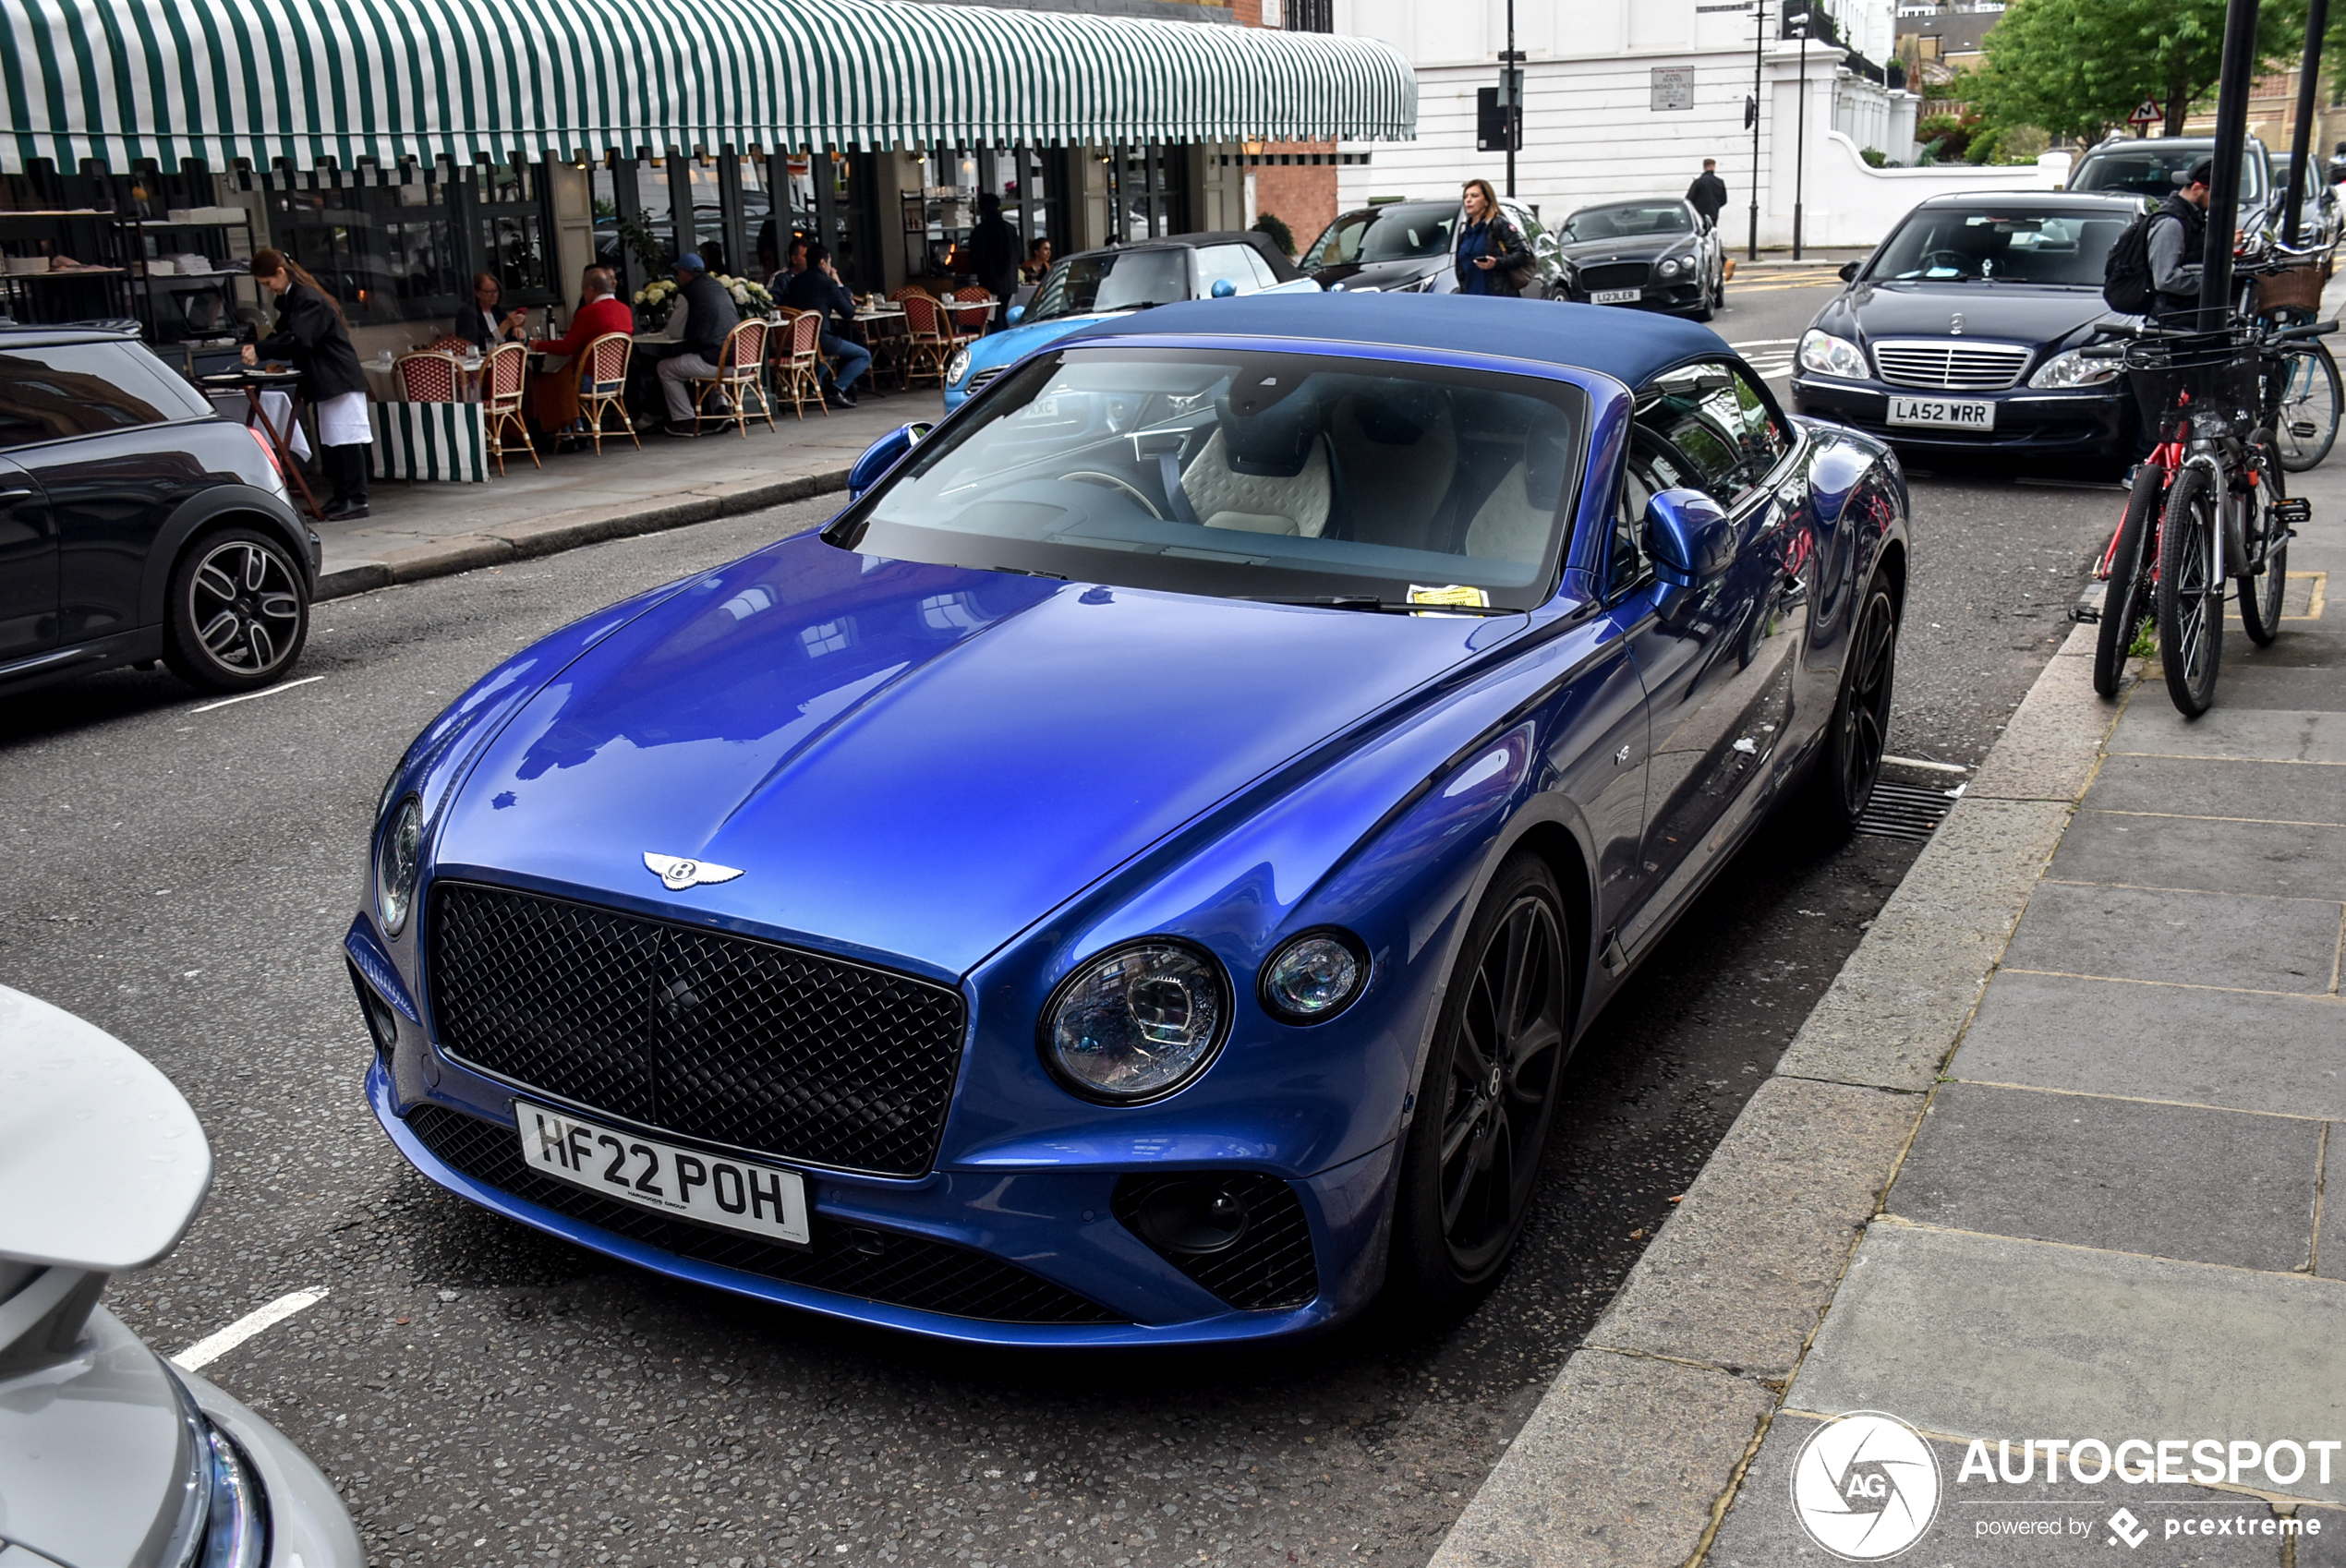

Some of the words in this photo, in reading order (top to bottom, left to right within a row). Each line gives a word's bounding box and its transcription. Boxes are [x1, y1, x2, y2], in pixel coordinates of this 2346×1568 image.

[1896, 402, 1944, 420] LA52
[1950, 404, 1986, 423] WRR
[536, 1113, 664, 1198] HF22
[674, 1152, 786, 1225] POH
[627, 1190, 663, 1205] HARWOODS
[664, 1200, 687, 1211] GROUP
